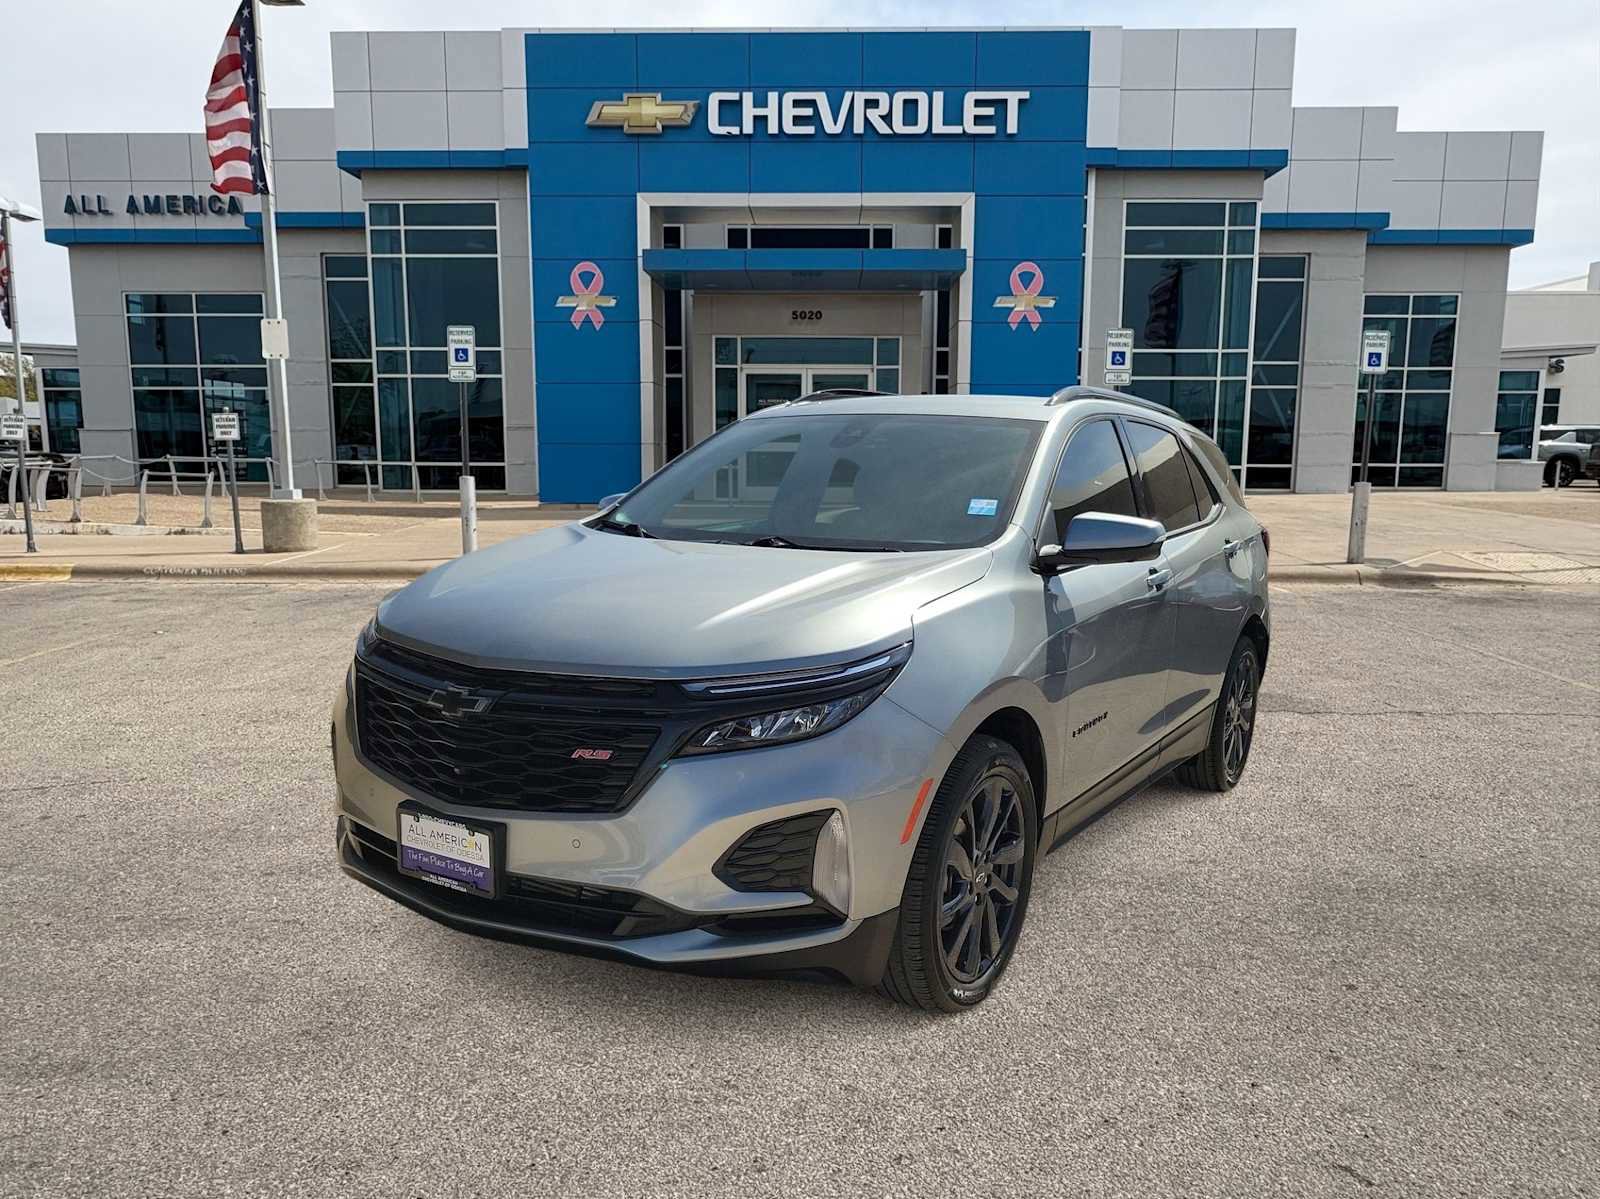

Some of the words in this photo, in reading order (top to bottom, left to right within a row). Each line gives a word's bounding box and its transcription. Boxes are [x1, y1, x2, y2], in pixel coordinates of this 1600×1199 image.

[707, 90, 1031, 136] CHEVROLET
[64, 194, 112, 215] ALL
[791, 310, 823, 320] 5020
[201, 566, 247, 576] PARKING
[571, 749, 613, 759] RS
[408, 824, 429, 837] ALL
[407, 835, 445, 850] CHEVROLET
[407, 849, 418, 859] The
[454, 863, 467, 876] Buy
[467, 866, 473, 875] A
[473, 868, 485, 878] Car
